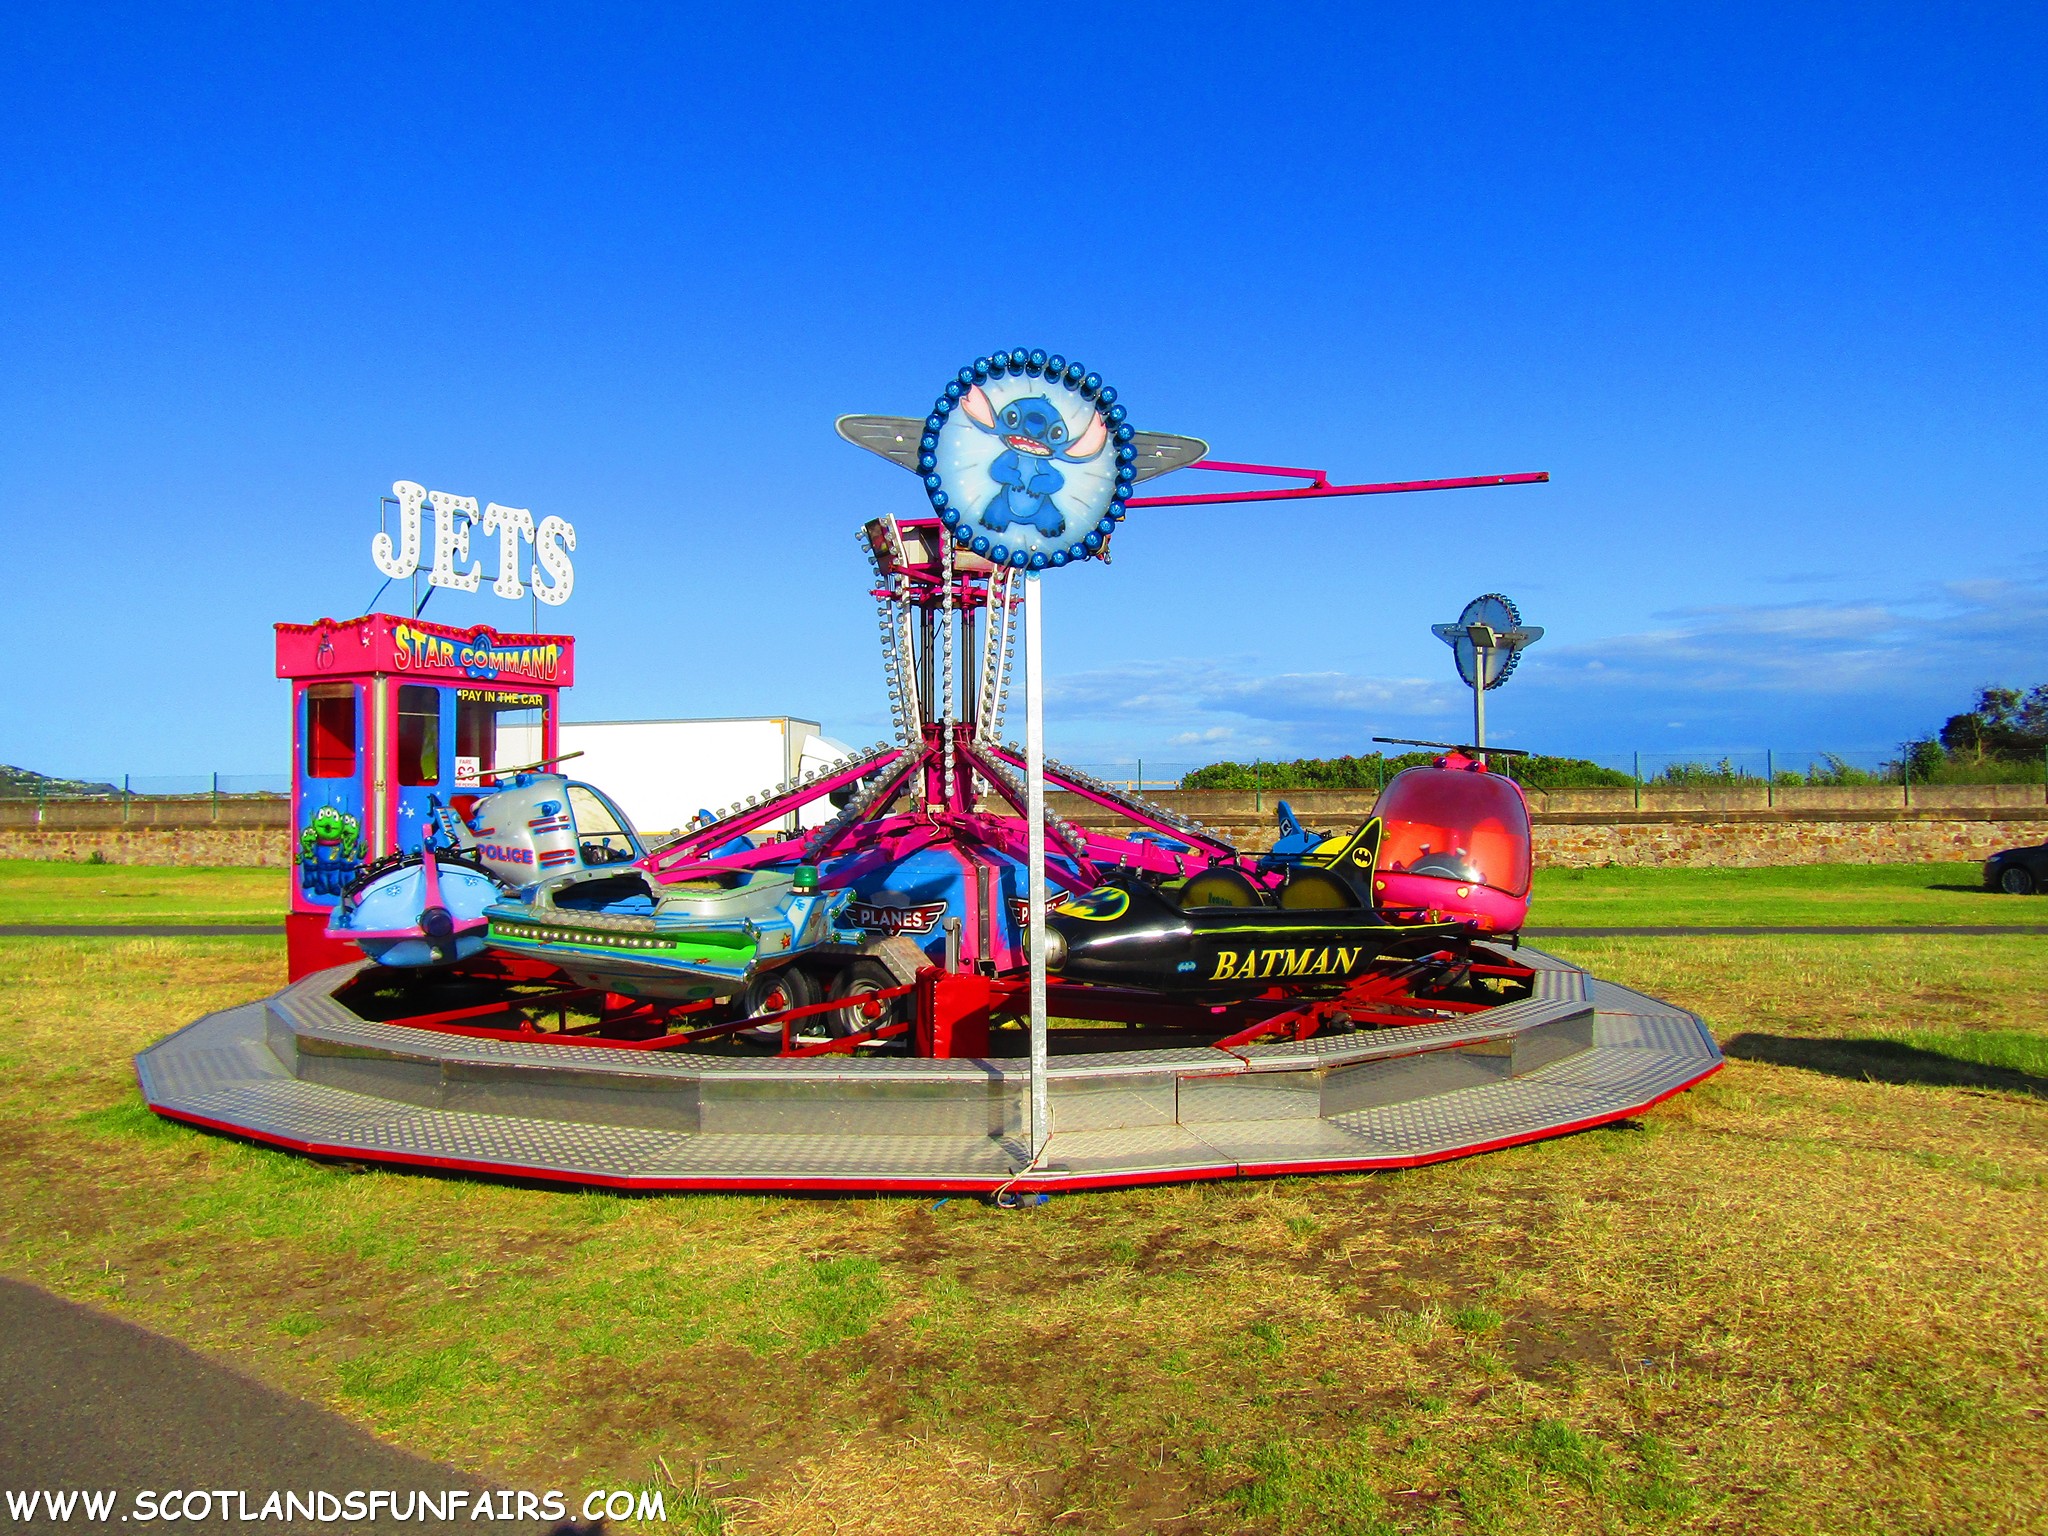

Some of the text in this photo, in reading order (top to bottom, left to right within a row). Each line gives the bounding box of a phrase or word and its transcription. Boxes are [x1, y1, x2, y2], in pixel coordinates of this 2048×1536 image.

[372, 480, 576, 606] JETS
[394, 624, 558, 681] STAR COMMAND
[461, 689, 543, 705] PAY IN THE CAR
[476, 843, 533, 865] POLICE
[861, 909, 922, 927] PLANES
[1208, 947, 1363, 981] BATMAN
